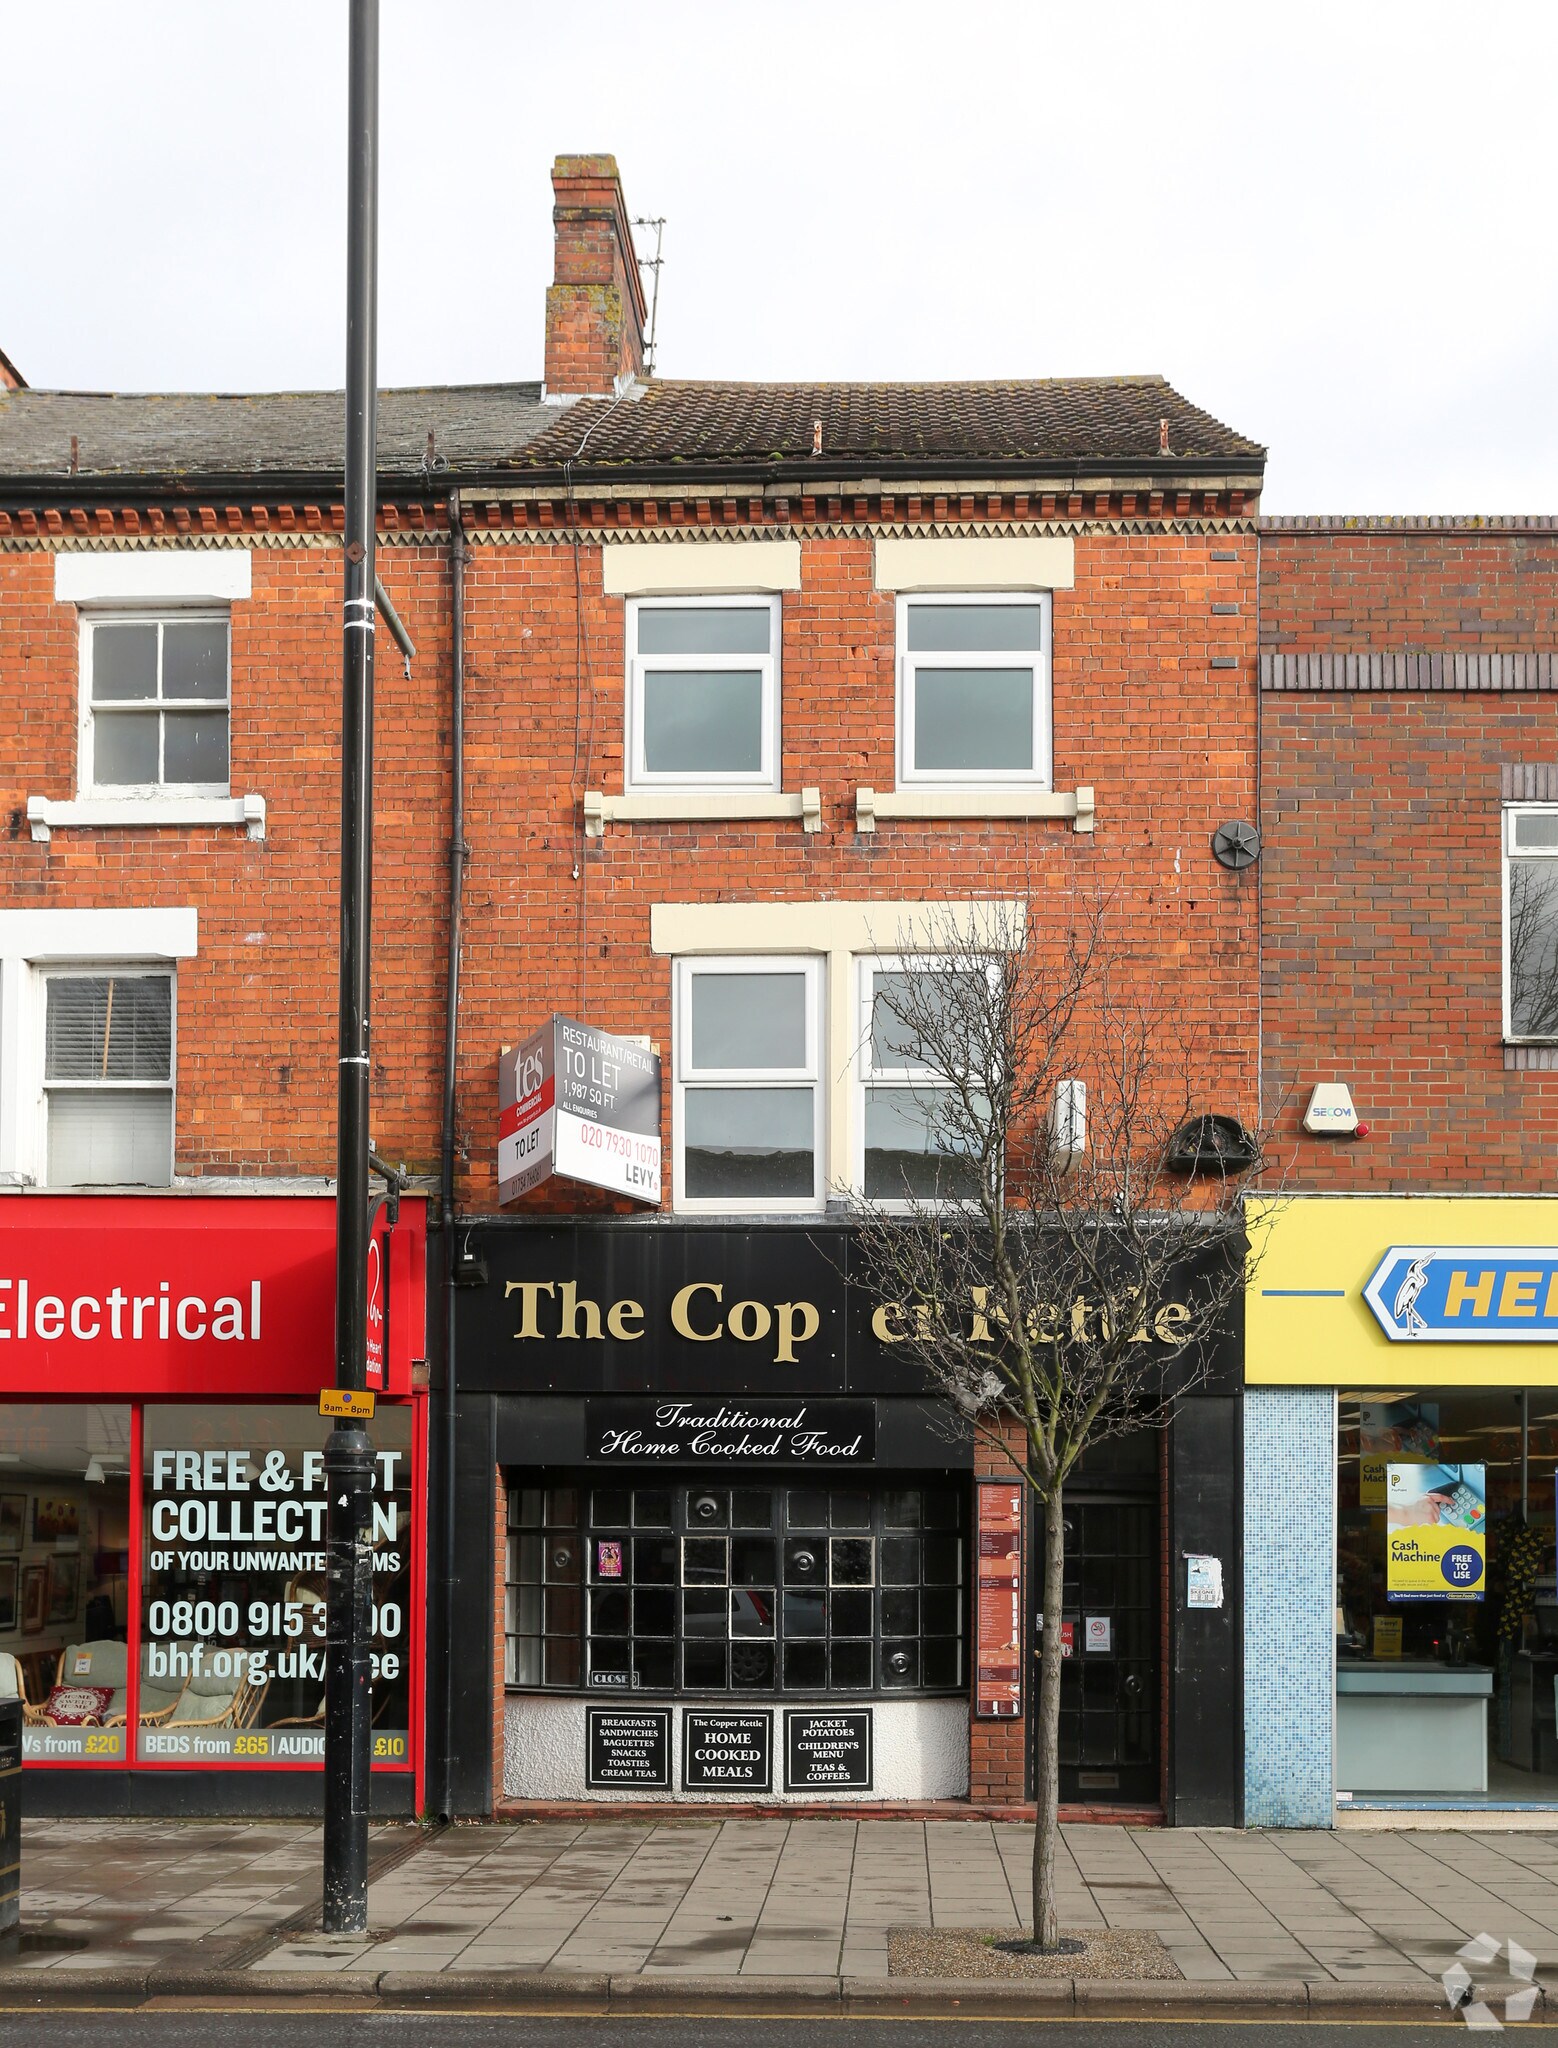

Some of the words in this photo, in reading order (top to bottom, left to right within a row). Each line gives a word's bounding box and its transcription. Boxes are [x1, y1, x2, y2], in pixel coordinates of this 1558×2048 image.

[563, 1025, 654, 1075] RESTAURANT/RETAIL
[514, 1046, 543, 1103] tes
[562, 1046, 585, 1078] TO
[591, 1056, 621, 1091] LET
[564, 1079, 587, 1099] 1,987
[589, 1088, 602, 1106] SQ
[604, 1093, 615, 1109] FT
[516, 1092, 542, 1117] COMMERCIAL
[563, 1101, 572, 1111] ALL
[573, 1104, 598, 1118] ENQUIRIES
[1312, 1107, 1351, 1117] SECOM
[515, 1138, 525, 1160] TO
[527, 1127, 540, 1153] LET
[581, 1123, 602, 1148] 020
[606, 1131, 632, 1158] 7930
[636, 1142, 659, 1167] 1070
[626, 1163, 654, 1189] LEVY
[504, 1279, 645, 1342] The
[369, 1338, 382, 1355] Heart
[366, 1355, 382, 1375] dation
[324, 1403, 343, 1412] 9am
[350, 1405, 370, 1415] 8pm
[655, 1403, 807, 1429] Traditional
[600, 1430, 681, 1455] Home
[687, 1430, 783, 1456] Cooked
[790, 1431, 862, 1456] Food
[153, 1450, 250, 1491] FREE
[259, 1449, 294, 1492] &
[303, 1450, 402, 1492] FT
[1363, 1464, 1385, 1473] Cash
[1363, 1474, 1387, 1483] Mach
[152, 1499, 398, 1542] COLLECTN
[1391, 1540, 1418, 1550] Cash
[150, 1550, 174, 1571] OF
[177, 1550, 229, 1571] YOUR
[233, 1551, 326, 1572] UNWANTE
[1391, 1551, 1440, 1562] Machine
[1451, 1554, 1473, 1563] FREE
[1455, 1562, 1469, 1571] TO
[1453, 1571, 1471, 1579] USE
[149, 1600, 239, 1637] 0800
[248, 1601, 304, 1637] 915
[148, 1642, 399, 1686] bhf.org.uk/ee
[601, 1719, 657, 1727] BREAKFASTS
[693, 1719, 708, 1727] The
[710, 1719, 738, 1728] Copper
[739, 1720, 763, 1728] Kettle
[809, 1720, 848, 1729] JACKET
[599, 1729, 658, 1737] SANDWICHES
[704, 1732, 752, 1744] HOME
[802, 1729, 855, 1737] POTATOES
[22, 1735, 41, 1753] Vs
[44, 1735, 82, 1753] from
[85, 1735, 119, 1753] £20
[145, 1735, 190, 1753] BEDS
[193, 1736, 230, 1754] from
[233, 1736, 268, 1754] £65
[373, 1737, 404, 1756] £10
[603, 1739, 655, 1747] BAGUETTES
[798, 1742, 859, 1750] CHILDREN'S
[611, 1749, 647, 1757] SNACKS
[694, 1749, 761, 1761] COOKED
[812, 1751, 844, 1759] MENU
[608, 1759, 650, 1767] TOASTIES
[810, 1764, 835, 1772] TEAS
[837, 1763, 847, 1772] &
[600, 1769, 632, 1777] CREAM
[702, 1766, 753, 1778] MEALS
[806, 1772, 851, 1781] COFFEES
